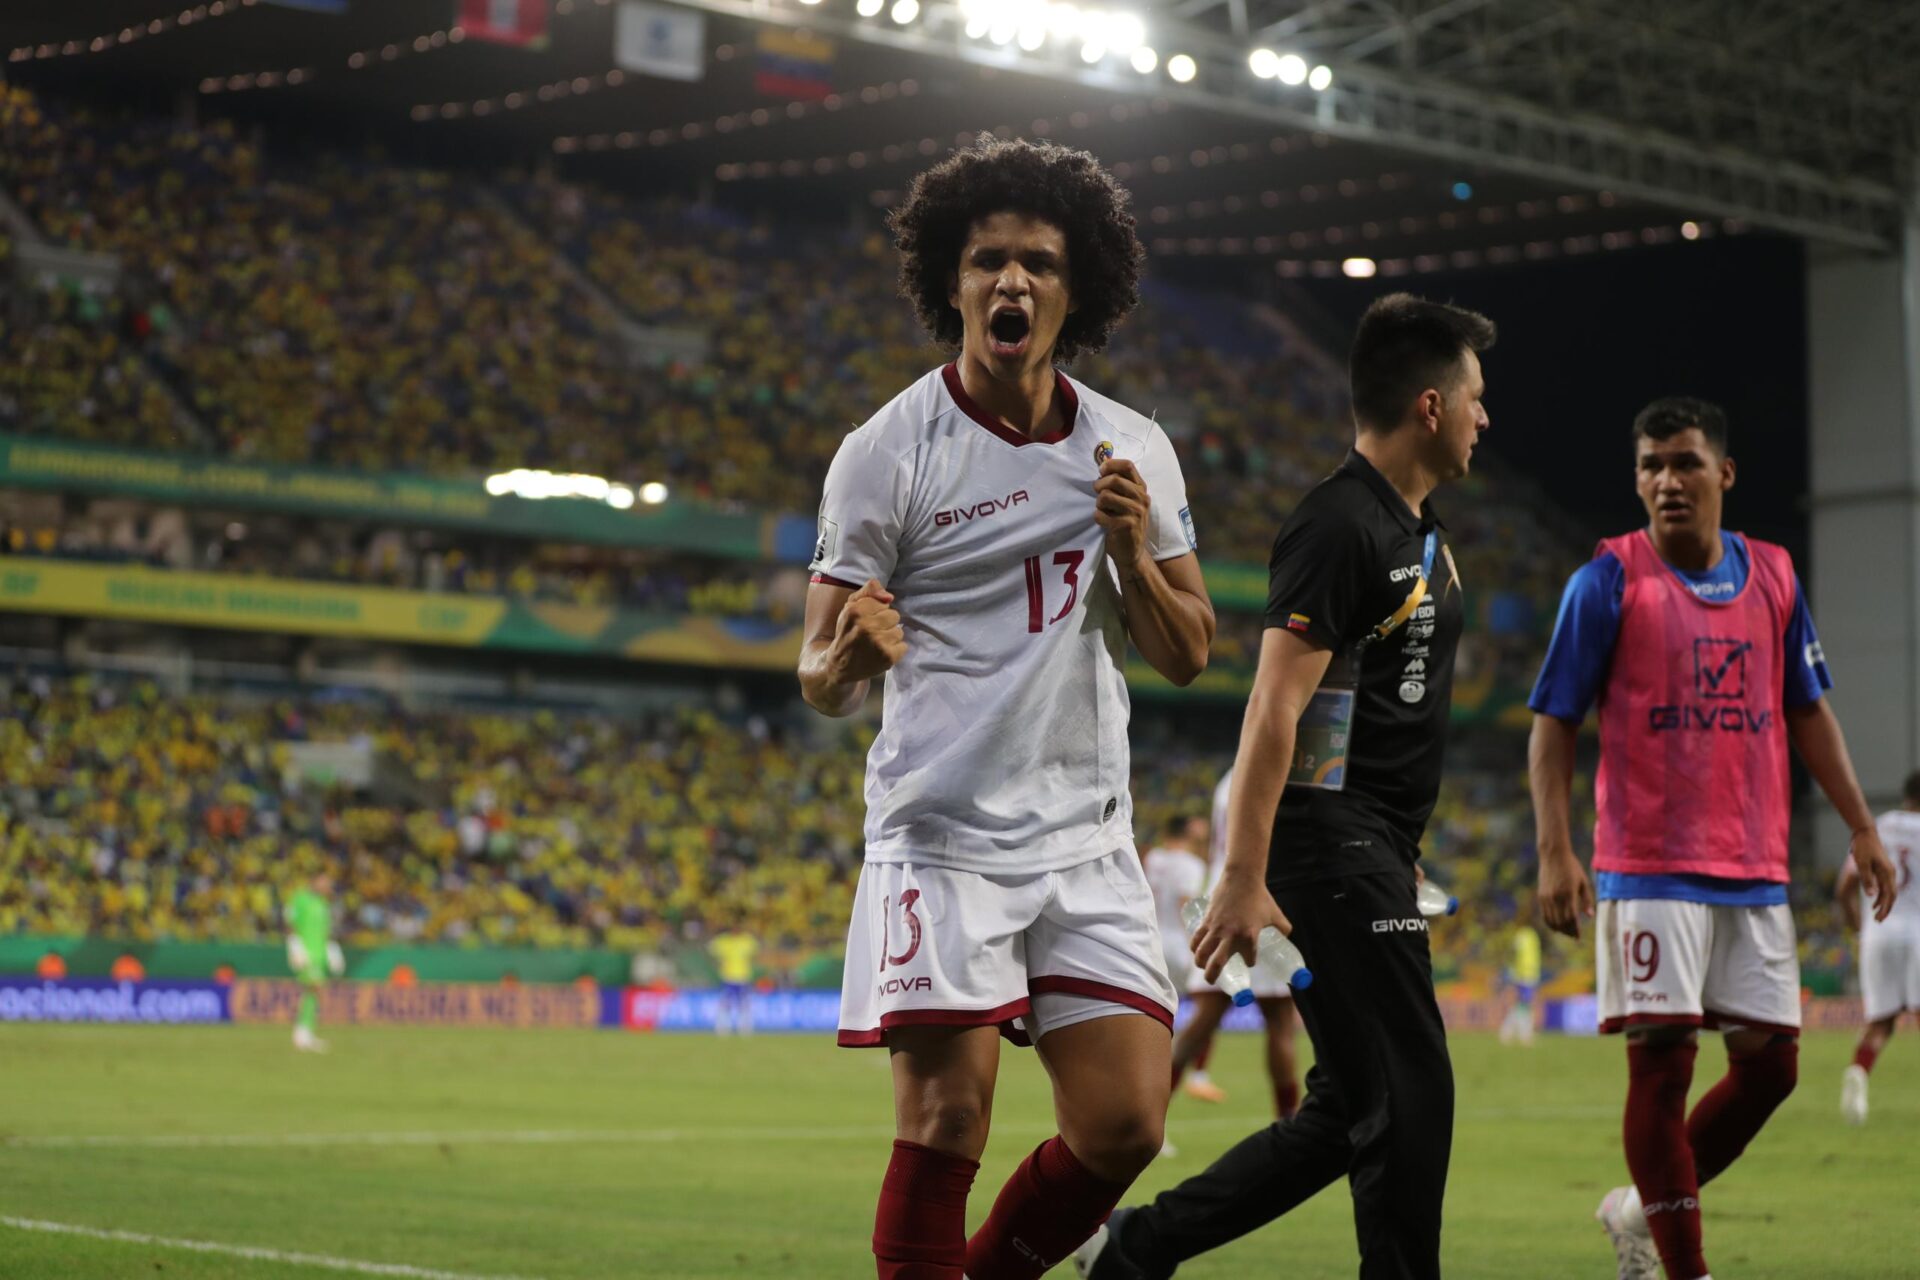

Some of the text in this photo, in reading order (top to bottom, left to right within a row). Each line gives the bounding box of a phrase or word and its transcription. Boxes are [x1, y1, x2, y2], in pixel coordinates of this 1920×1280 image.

[935, 490, 1029, 526] GIVOVA
[1025, 550, 1084, 633] 13
[1389, 564, 1424, 582] GIVO
[1649, 704, 1772, 733] GIVOV
[880, 888, 921, 973] 13
[1623, 930, 1661, 983] 19
